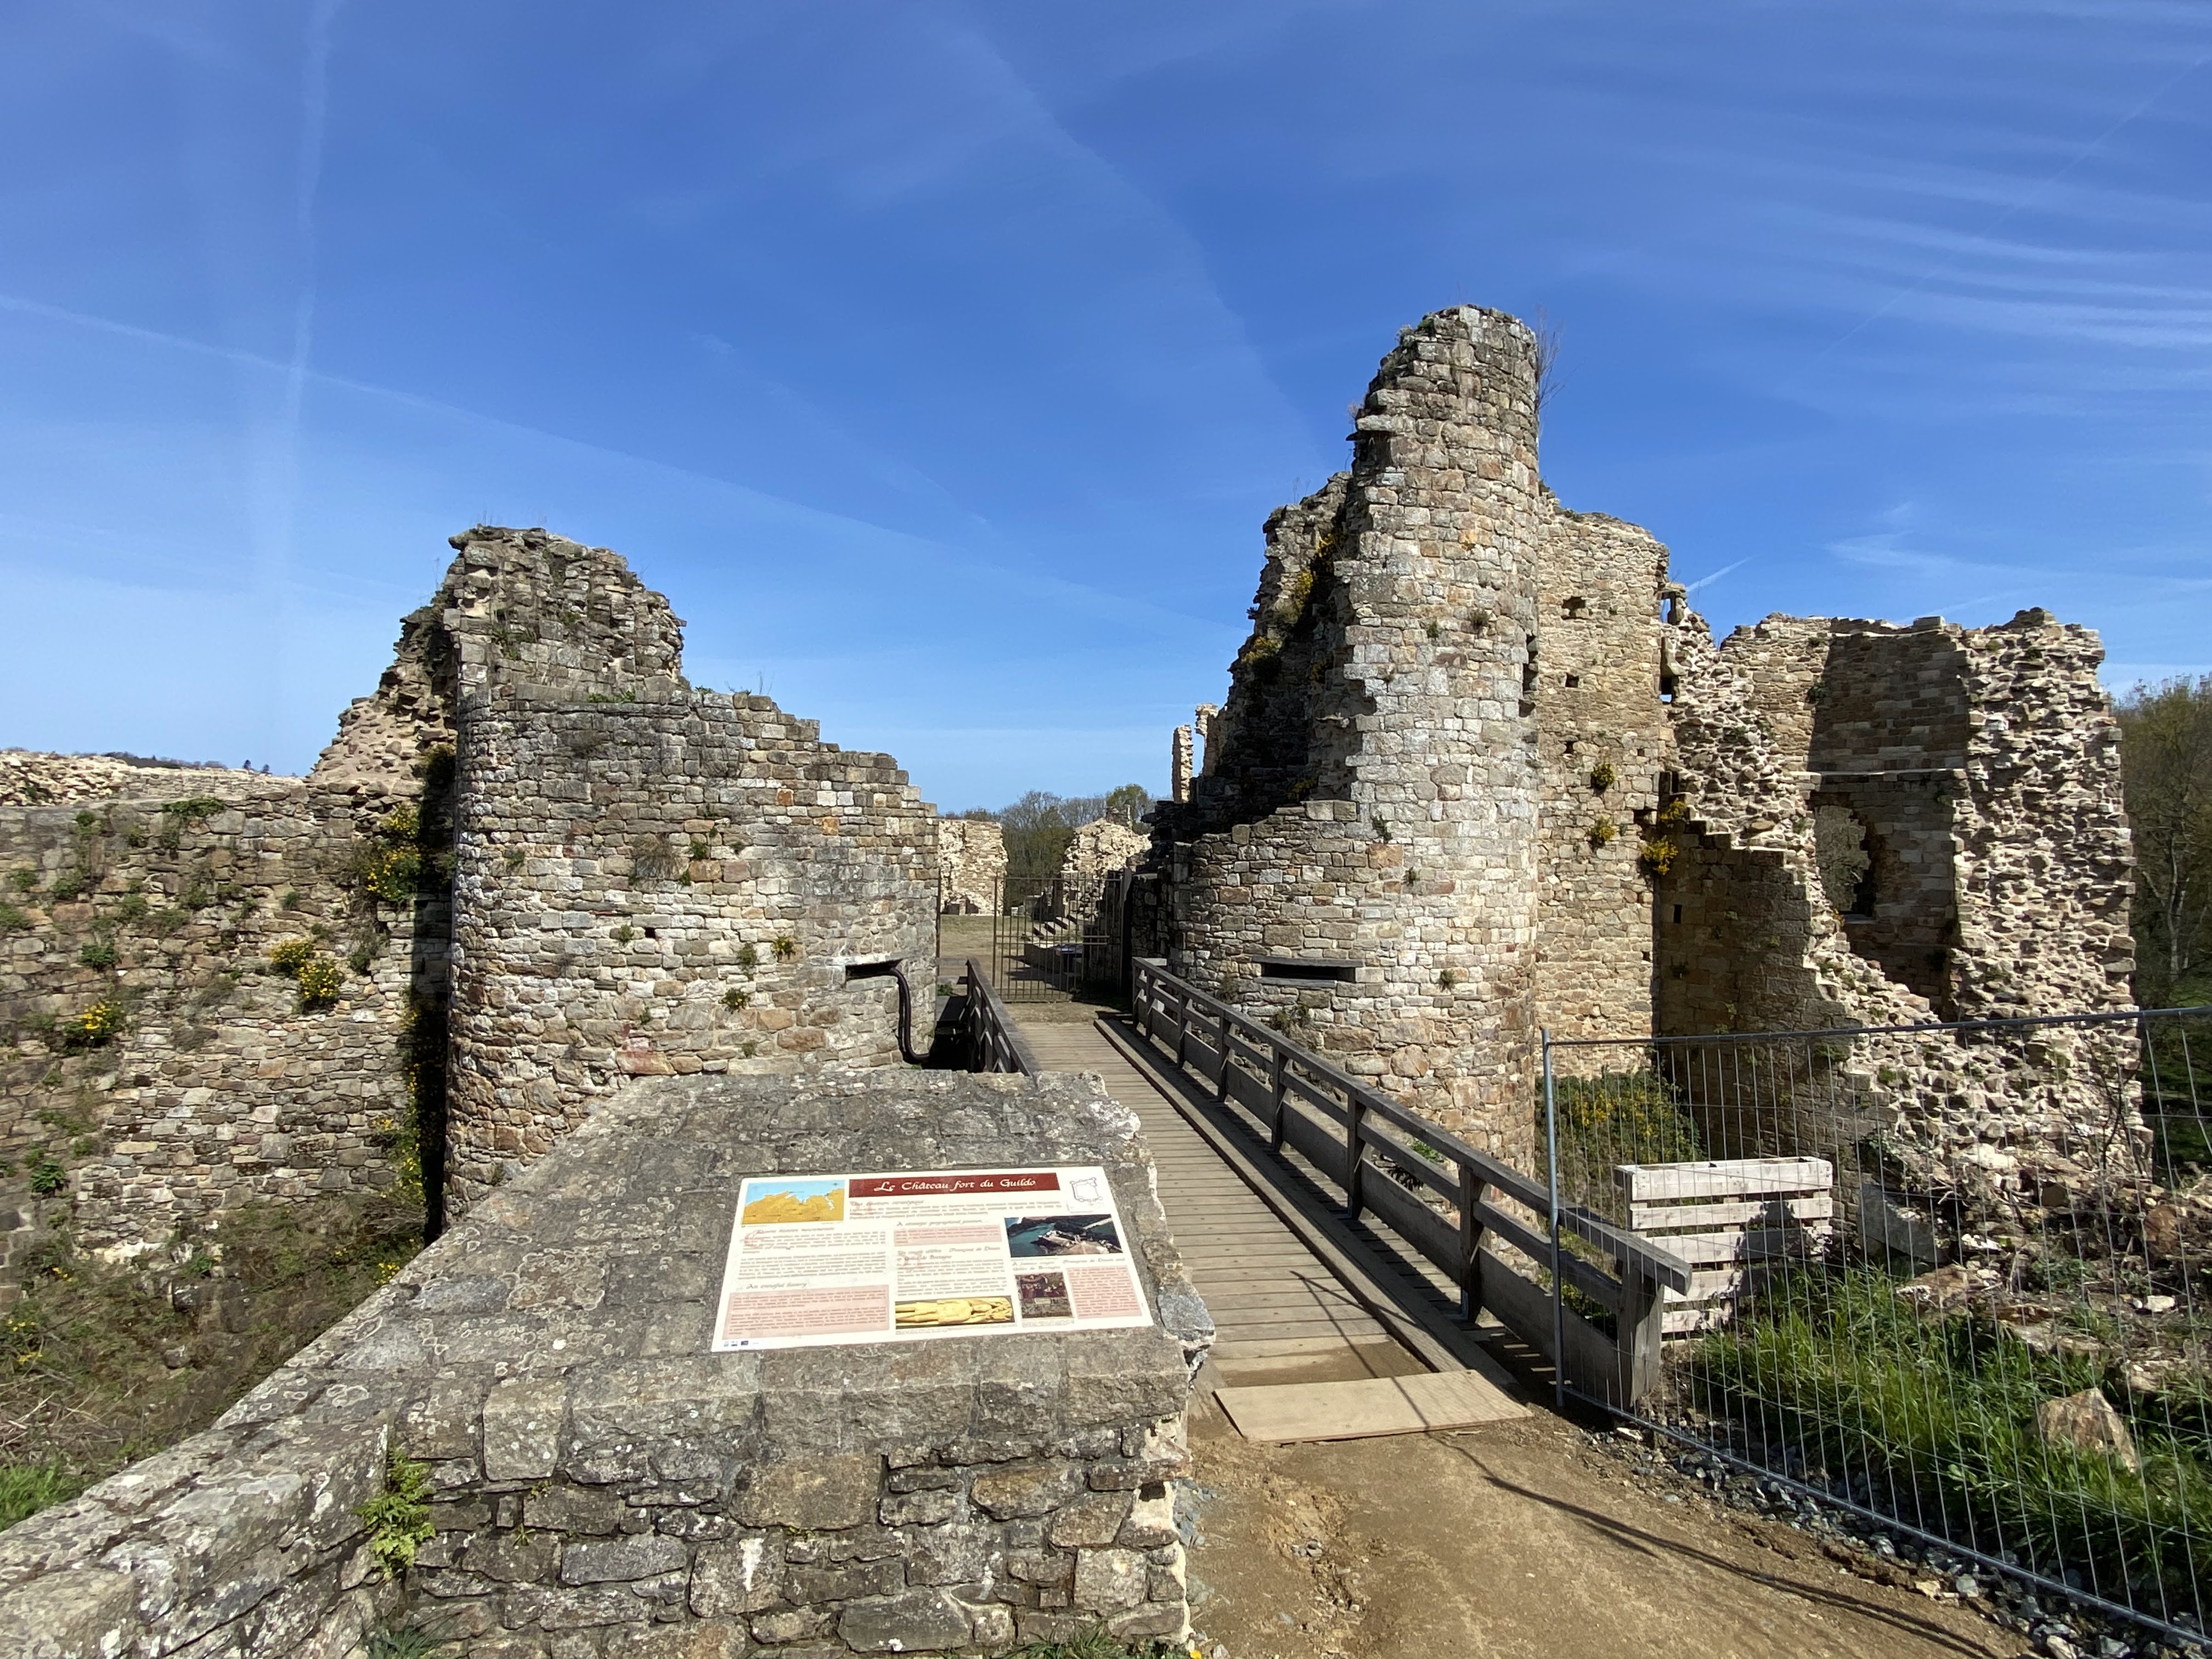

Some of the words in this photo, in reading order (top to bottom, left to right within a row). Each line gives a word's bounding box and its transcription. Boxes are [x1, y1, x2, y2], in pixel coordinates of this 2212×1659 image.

[873, 1181, 896, 1192] Le
[901, 1181, 949, 1190] Château
[949, 1180, 975, 1192] fort
[980, 1179, 994, 1188] du
[1000, 1178, 1036, 1188] Guildo
